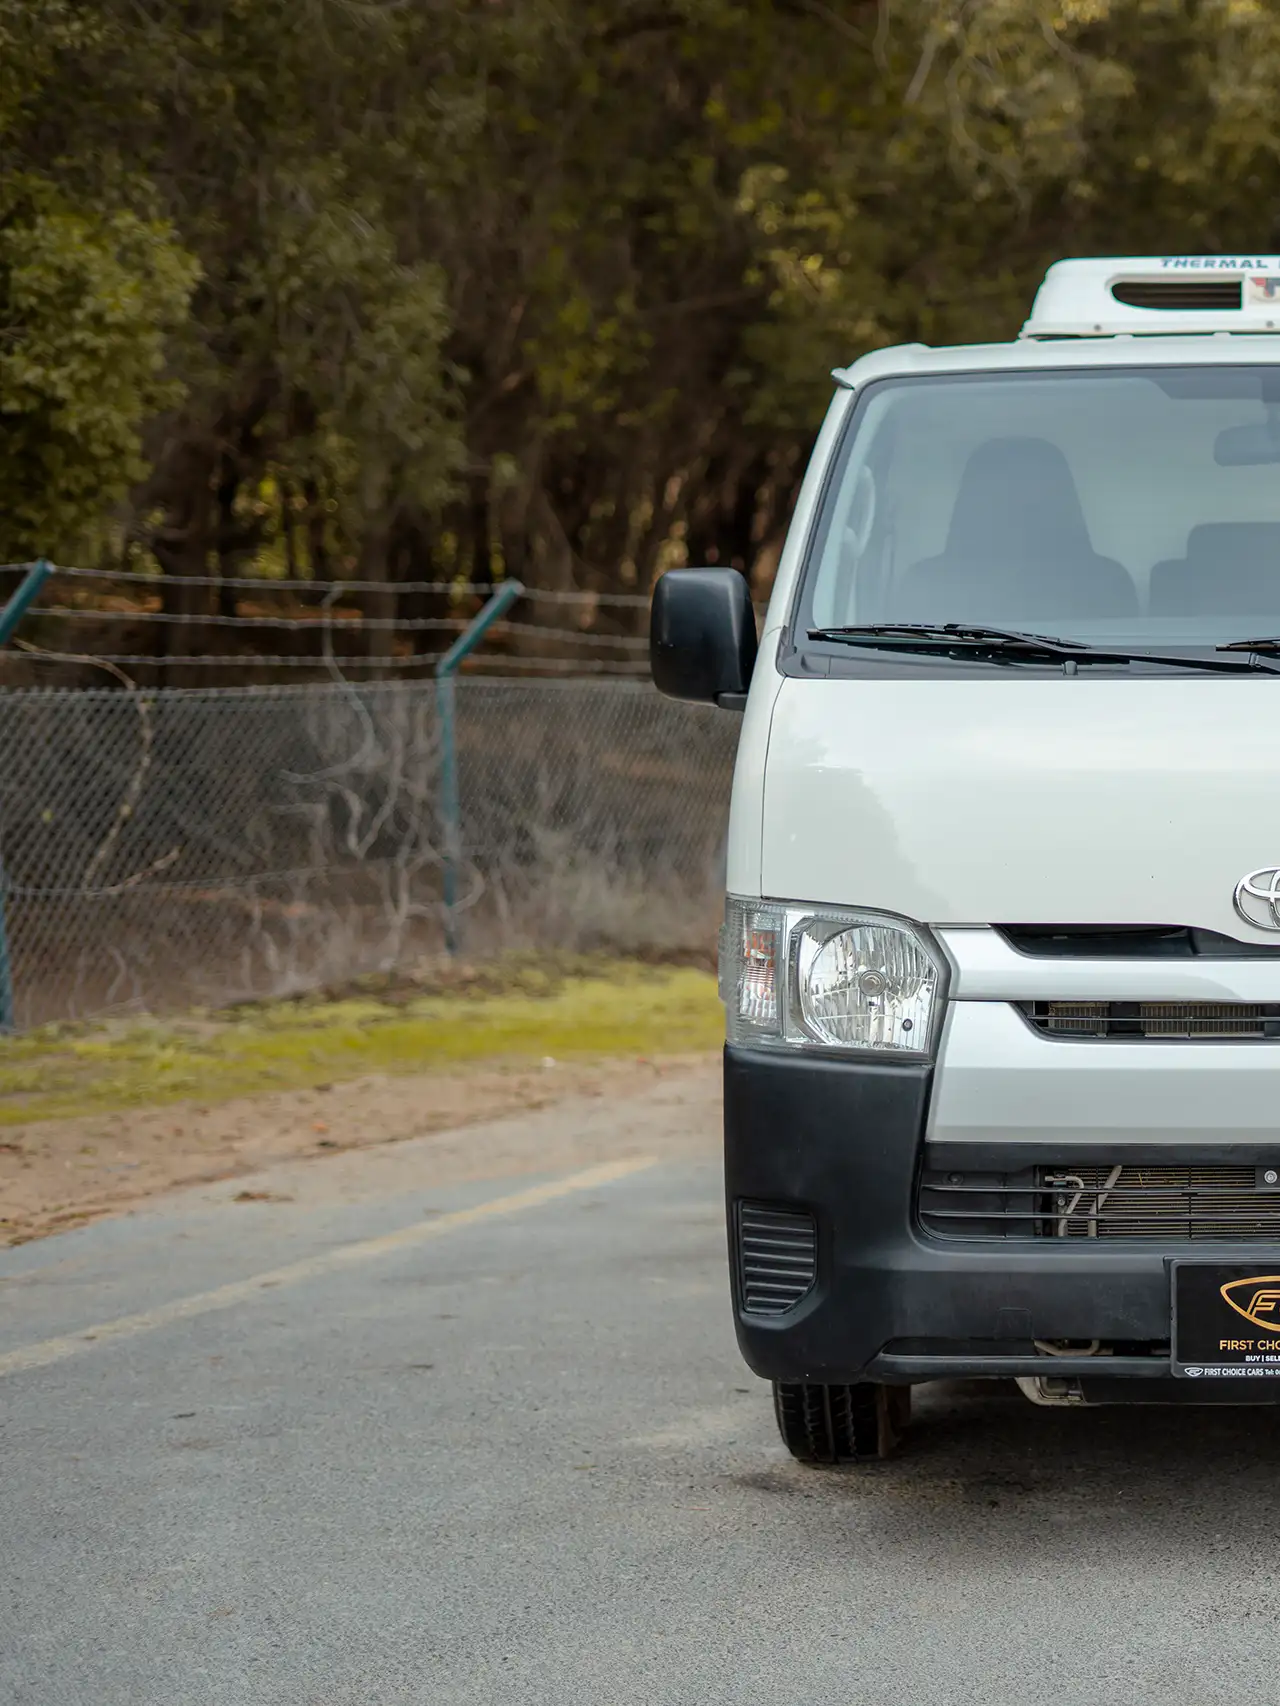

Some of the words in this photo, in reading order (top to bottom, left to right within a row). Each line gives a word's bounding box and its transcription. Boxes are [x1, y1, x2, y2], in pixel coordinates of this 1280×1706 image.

[1161, 258, 1268, 268] THERMAL
[1219, 1340, 1254, 1350] FIRST
[1204, 1368, 1221, 1376] FIRST
[1222, 1368, 1245, 1376] CHOICE
[1247, 1368, 1263, 1376] CARS
